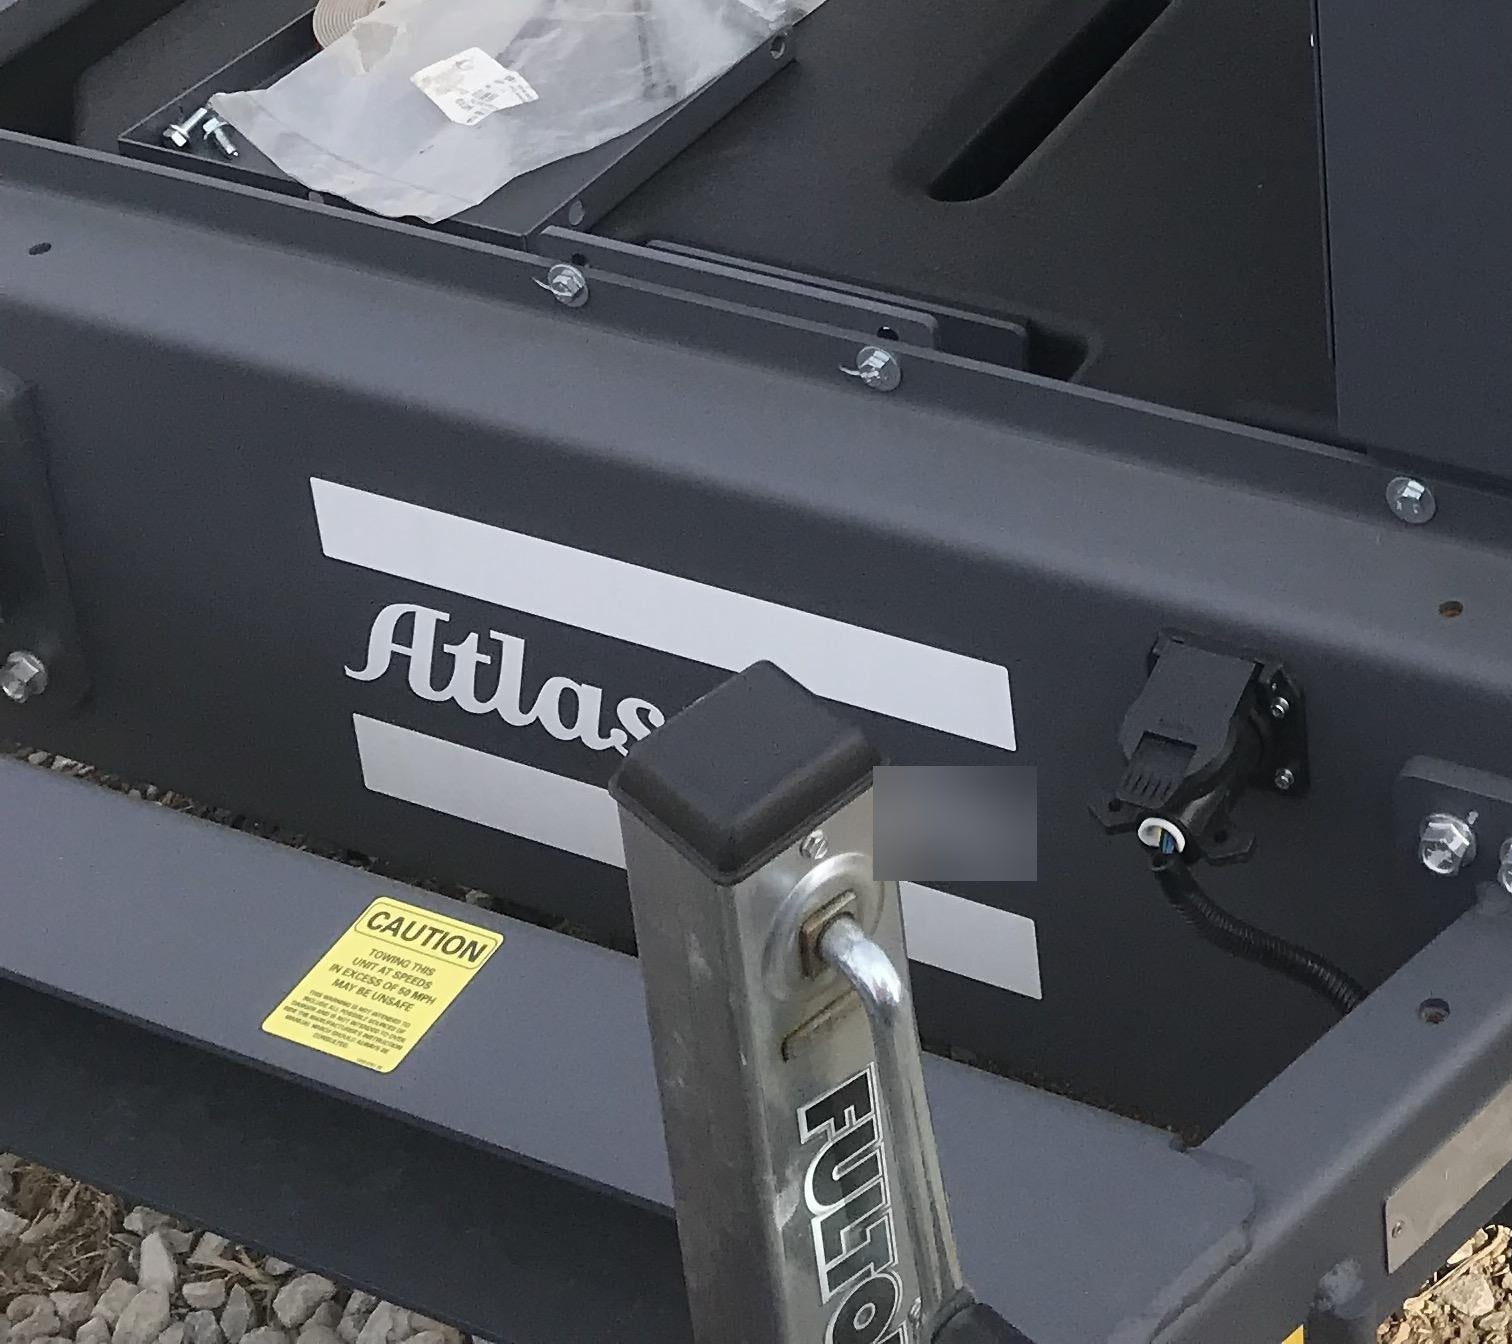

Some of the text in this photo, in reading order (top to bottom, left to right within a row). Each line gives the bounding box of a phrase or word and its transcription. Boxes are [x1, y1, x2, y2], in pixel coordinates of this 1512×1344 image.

[343, 602, 667, 756] Atlas
[366, 911, 488, 963] CAUTION
[352, 958, 432, 988] UNIT AT SPEEDS
[368, 949, 435, 975] TOWING THIS
[330, 964, 434, 1004] IN EXCESS OF 50 MPH
[333, 979, 412, 1011] MAY BE UNSAFE
[797, 1061, 908, 1344] FULTO
